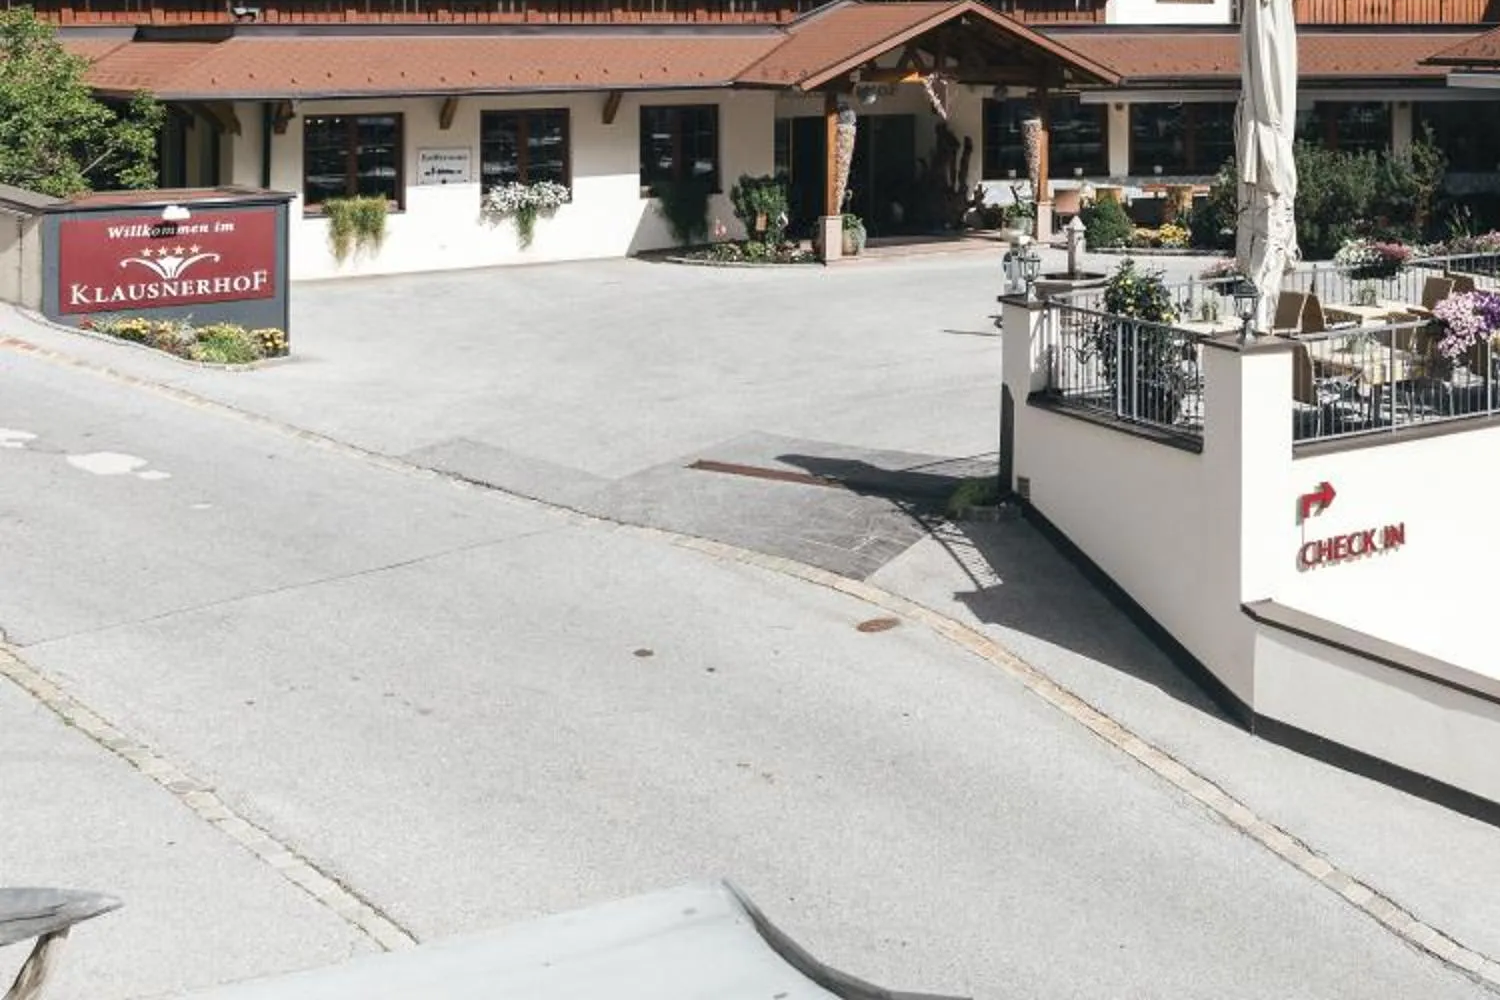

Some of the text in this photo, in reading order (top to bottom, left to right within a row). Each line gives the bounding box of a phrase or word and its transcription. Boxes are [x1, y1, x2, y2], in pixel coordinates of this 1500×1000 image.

[107, 220, 235, 239] Willkommen im
[70, 269, 268, 306] KLAUSNERHOF
[1300, 522, 1406, 567] CHECK IN
